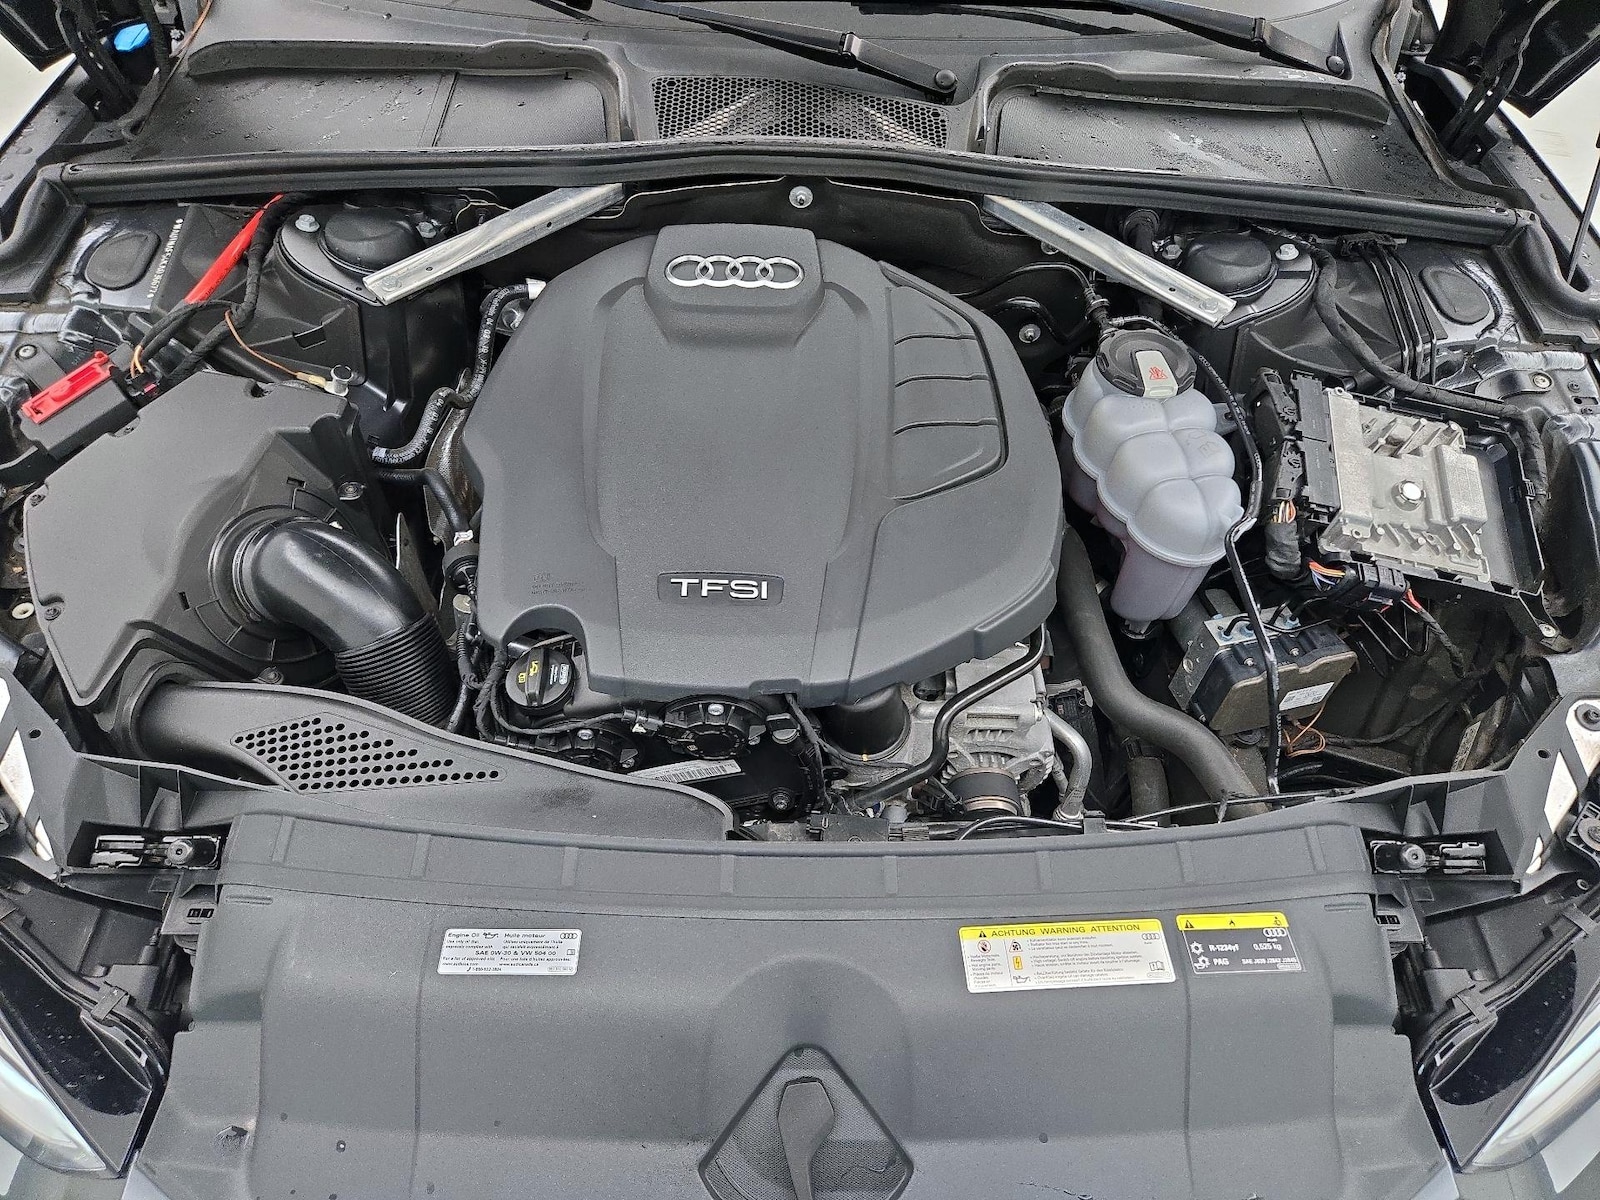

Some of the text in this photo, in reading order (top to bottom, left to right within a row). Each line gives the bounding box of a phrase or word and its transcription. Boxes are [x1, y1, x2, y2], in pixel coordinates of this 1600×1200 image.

[670, 578, 768, 600] TFSI
[992, 924, 1140, 937] ACHTUNG WARNING ATTENTION
[1272, 943, 1282, 951] kg
[1212, 957, 1230, 966] PAG
